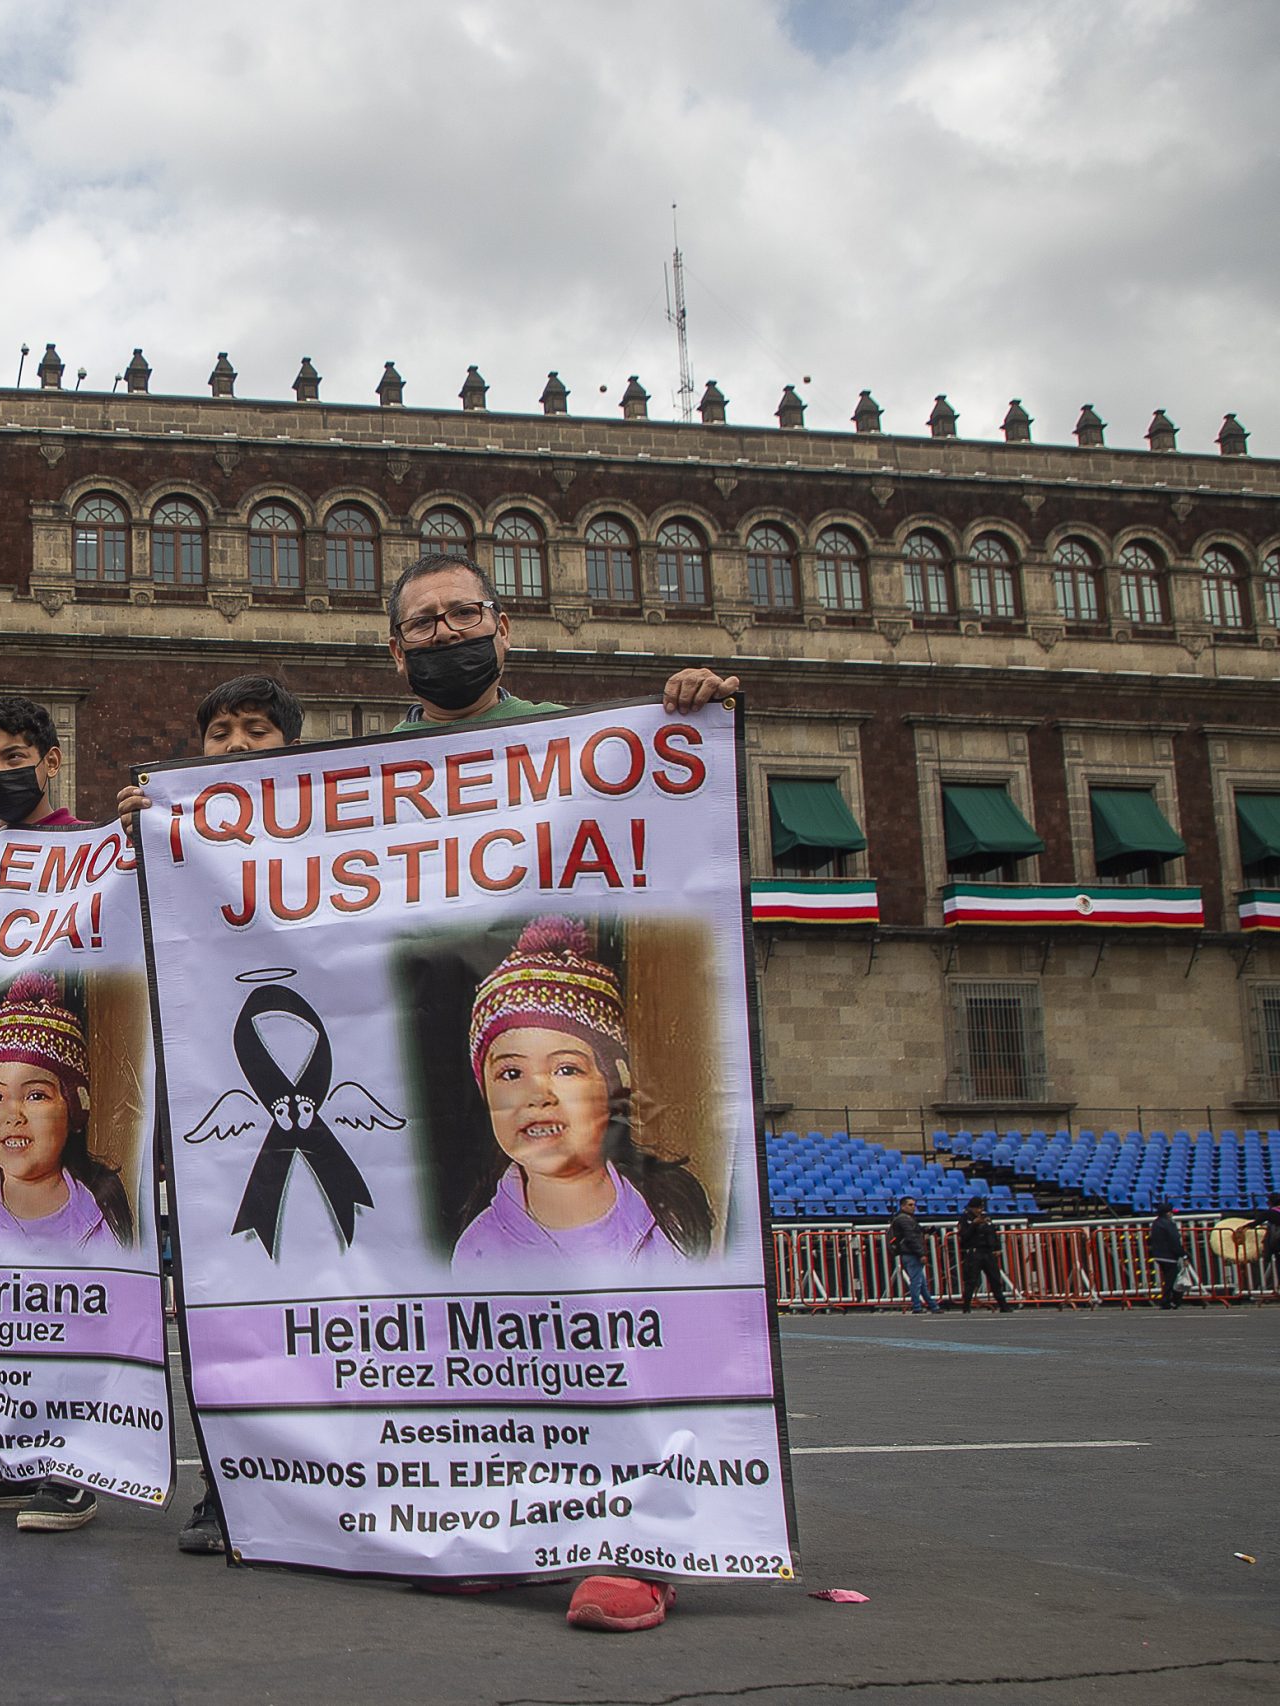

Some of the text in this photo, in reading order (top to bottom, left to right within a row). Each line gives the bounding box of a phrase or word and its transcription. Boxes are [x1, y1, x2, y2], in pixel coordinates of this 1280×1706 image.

[170, 723, 705, 864] ¡QUEREMOS
[220, 818, 648, 928] JUSTICIA!
[285, 1301, 663, 1356] Heidi Mariana
[335, 1356, 627, 1396] Pérez Rodríguez
[45, 1401, 164, 1431] MEXICANO
[380, 1420, 590, 1450] Asesinada por
[17, 1463, 36, 1478] de
[38, 1457, 84, 1478] Agosto
[87, 1471, 117, 1490] del
[117, 1480, 162, 1500] 2022
[220, 1457, 366, 1488] SOLDADOS
[377, 1461, 440, 1488] DEL
[450, 1453, 602, 1488] EJÉRCITO
[339, 1491, 633, 1533] en Nuevo Laredo
[535, 1541, 784, 1574] 31 de Agosto del 2022
